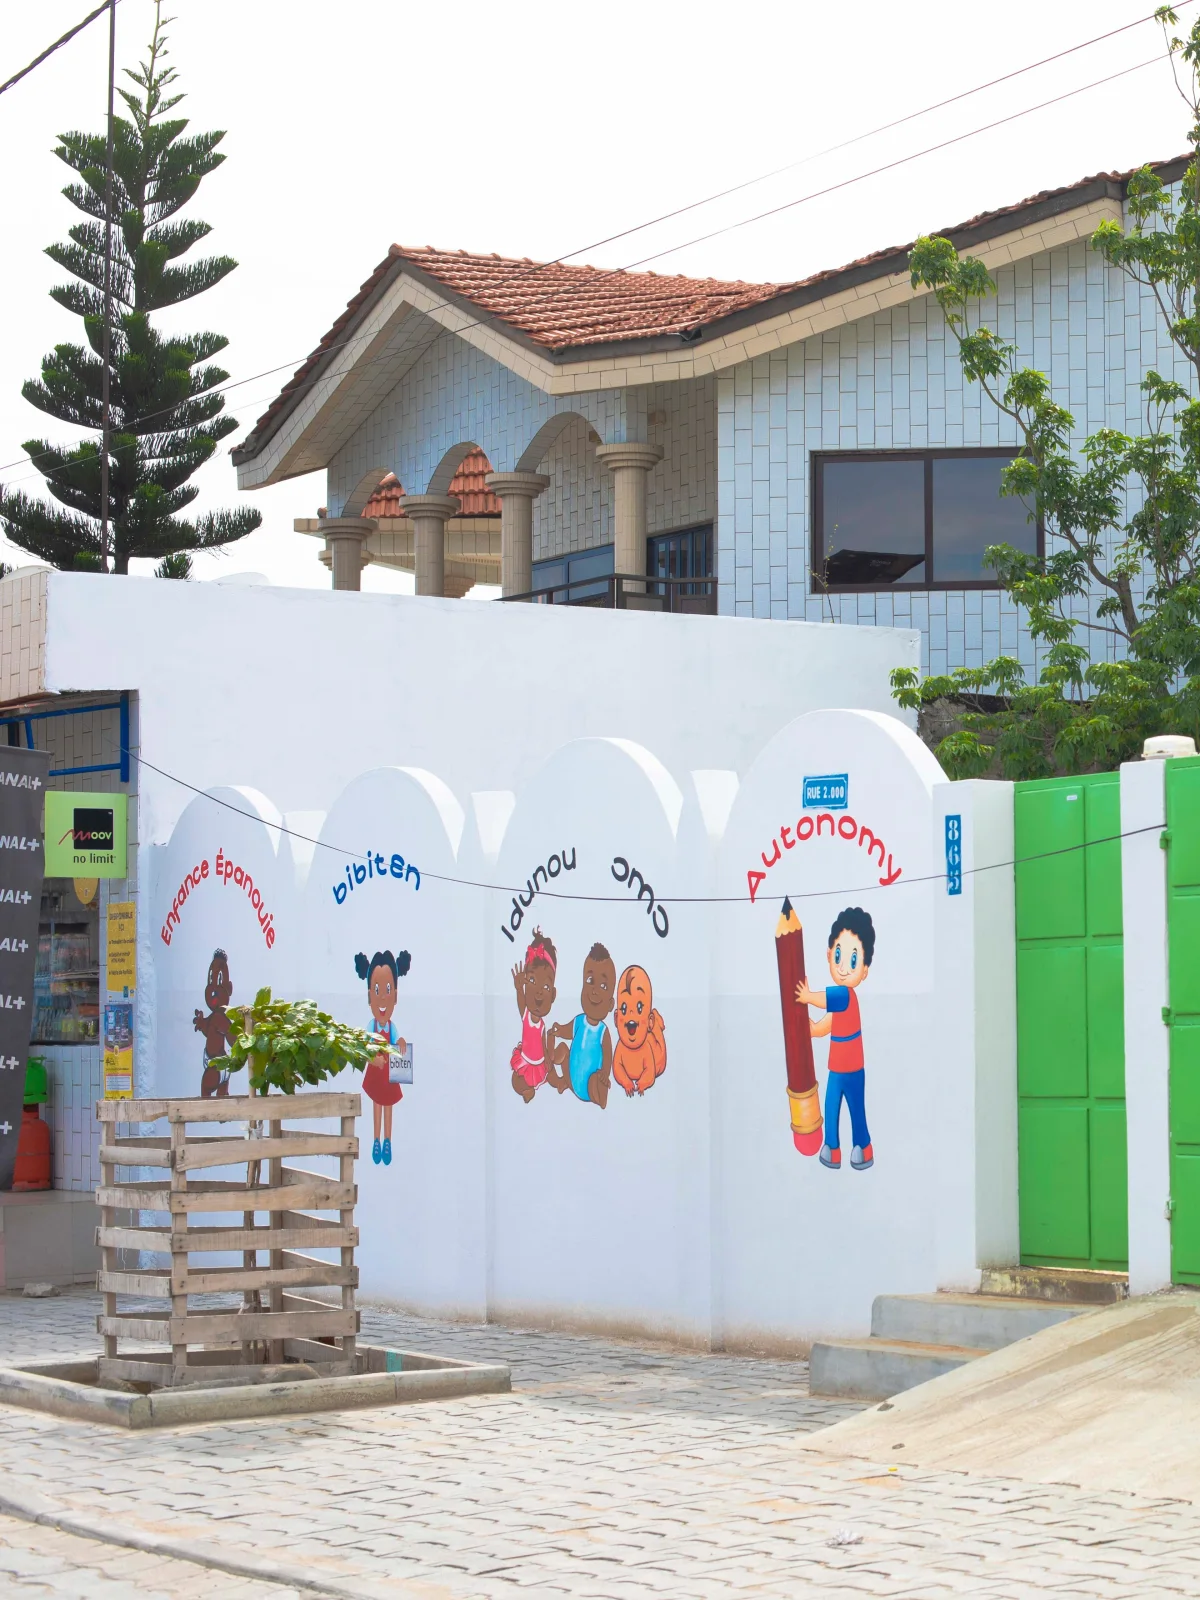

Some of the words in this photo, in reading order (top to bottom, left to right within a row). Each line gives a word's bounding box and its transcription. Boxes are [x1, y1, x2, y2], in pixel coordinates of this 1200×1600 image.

[807, 786, 821, 799] RUE
[823, 786, 844, 799] 2.000
[73, 855, 86, 863] no
[90, 853, 114, 863] limit
[747, 813, 901, 903] Autonomy
[161, 860, 209, 946] Enfance
[216, 847, 275, 949] Épanouie
